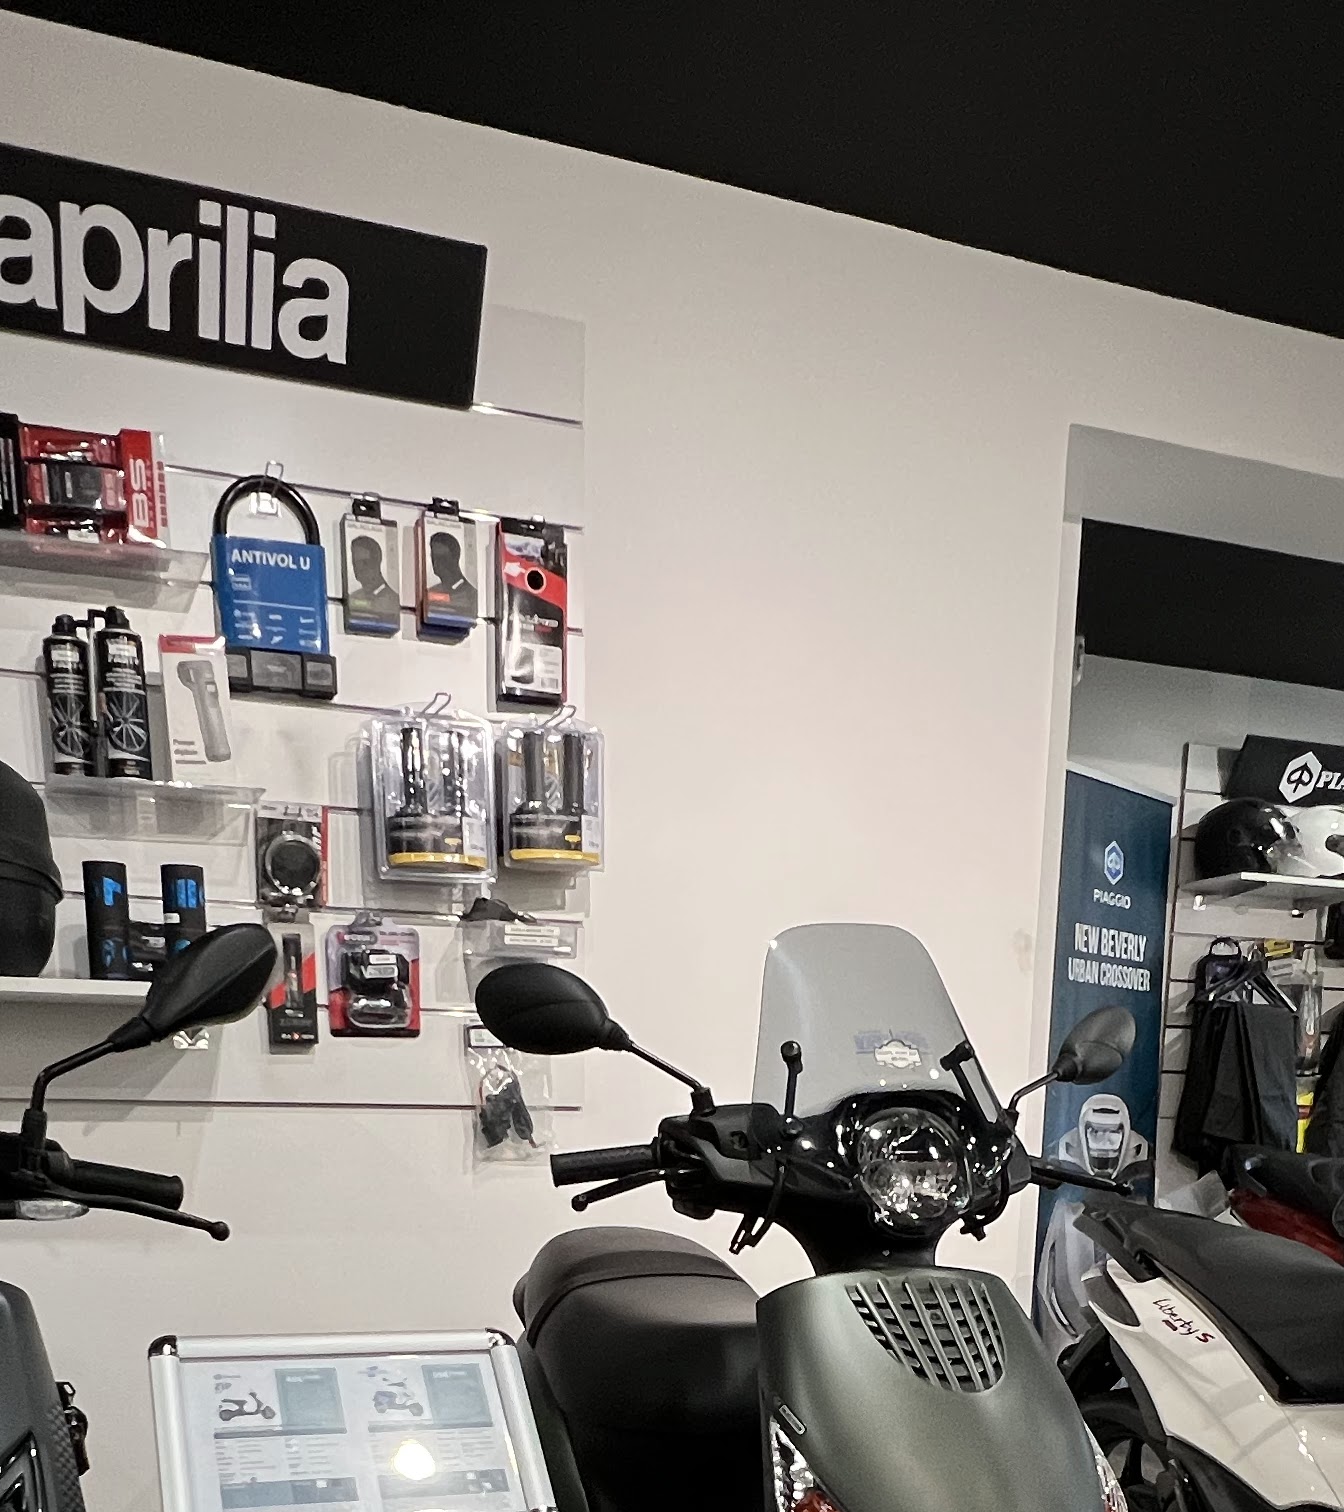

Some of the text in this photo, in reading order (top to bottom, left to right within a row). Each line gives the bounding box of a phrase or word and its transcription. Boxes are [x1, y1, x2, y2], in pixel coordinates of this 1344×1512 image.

[129, 458, 149, 528] BS
[231, 549, 311, 571] ANTIVOL U
[1093, 888, 1132, 910] PIAGGIO
[1074, 922, 1147, 963] NEW BEVERLY
[1068, 956, 1151, 992] URBAN CROSSOVER
[1152, 1298, 1217, 1343] Liberty S
